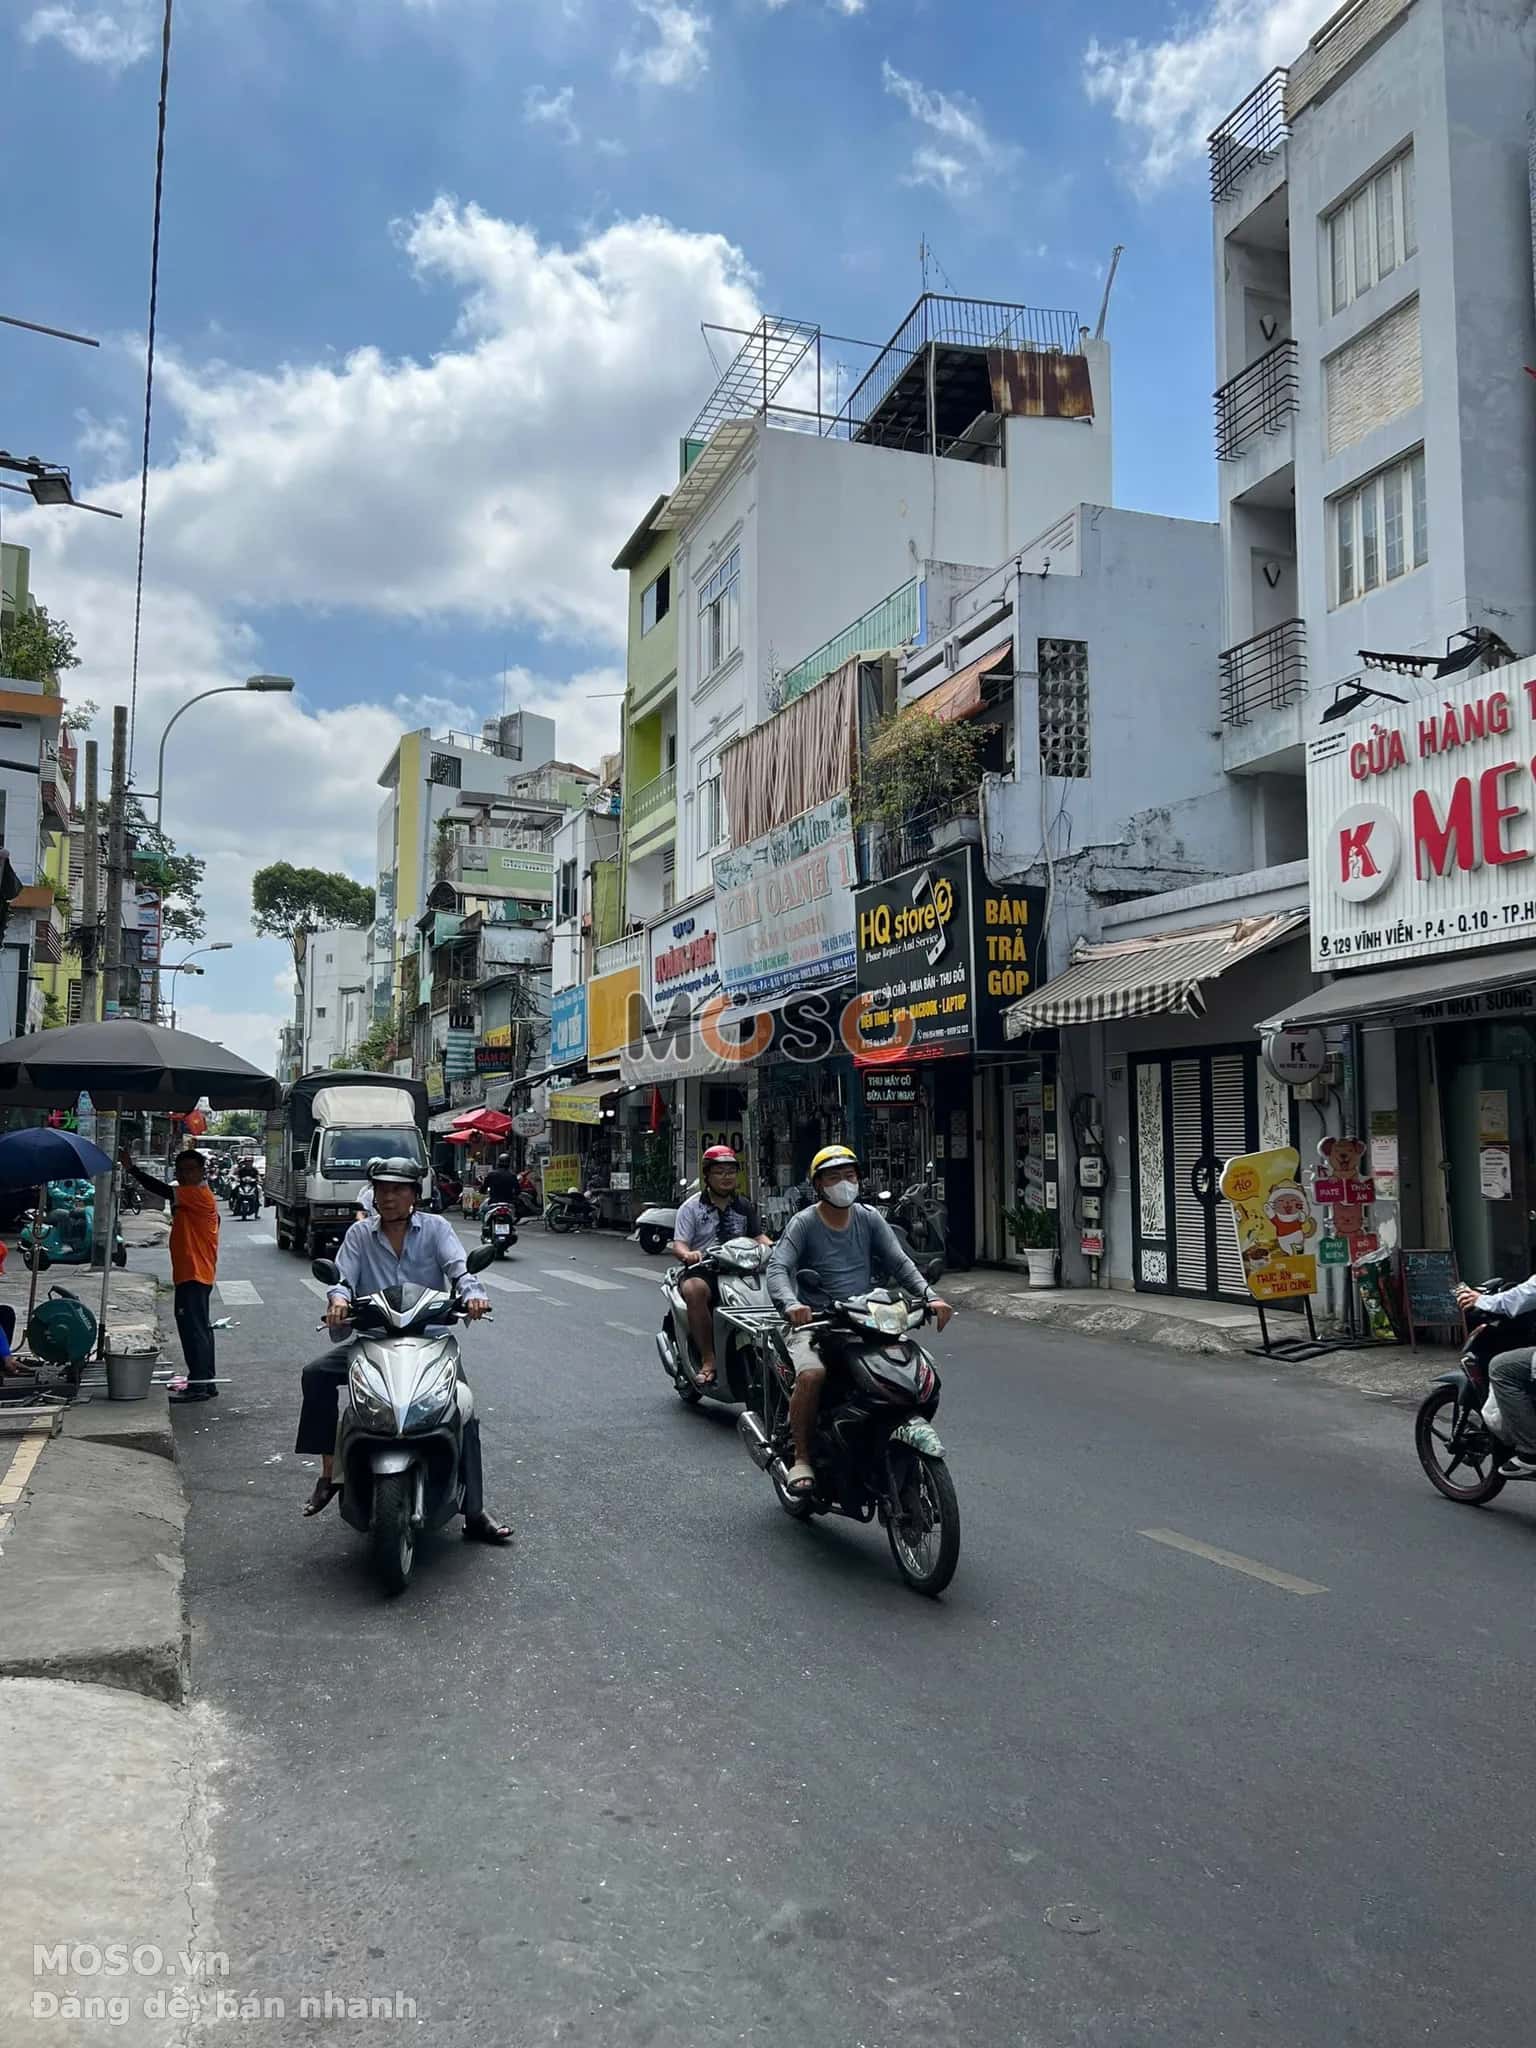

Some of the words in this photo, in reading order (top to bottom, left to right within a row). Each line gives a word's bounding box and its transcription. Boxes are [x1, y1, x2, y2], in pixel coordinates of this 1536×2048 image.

[1350, 724, 1405, 779] CỬA
[1419, 691, 1508, 757] HÀNG
[1413, 755, 1536, 881] ME
[985, 894, 1028, 925] BÁN
[861, 904, 891, 951] HQ
[895, 904, 935, 939] store
[1333, 936, 1351, 954] 129
[1355, 930, 1382, 950] VĨNH
[1385, 919, 1413, 945] VIỄN
[1425, 919, 1445, 939] P.4
[1458, 910, 1488, 933] Q.10
[1502, 900, 1536, 924] TP.H
[902, 938, 915, 952] And
[916, 934, 939, 948] Service
[986, 928, 1027, 961] TRẢ
[924, 973, 936, 988] BÁN
[940, 970, 952, 985] THU
[988, 965, 1029, 996] GÓP
[867, 1089, 881, 1101] SỬA
[868, 1076, 882, 1086] THU
